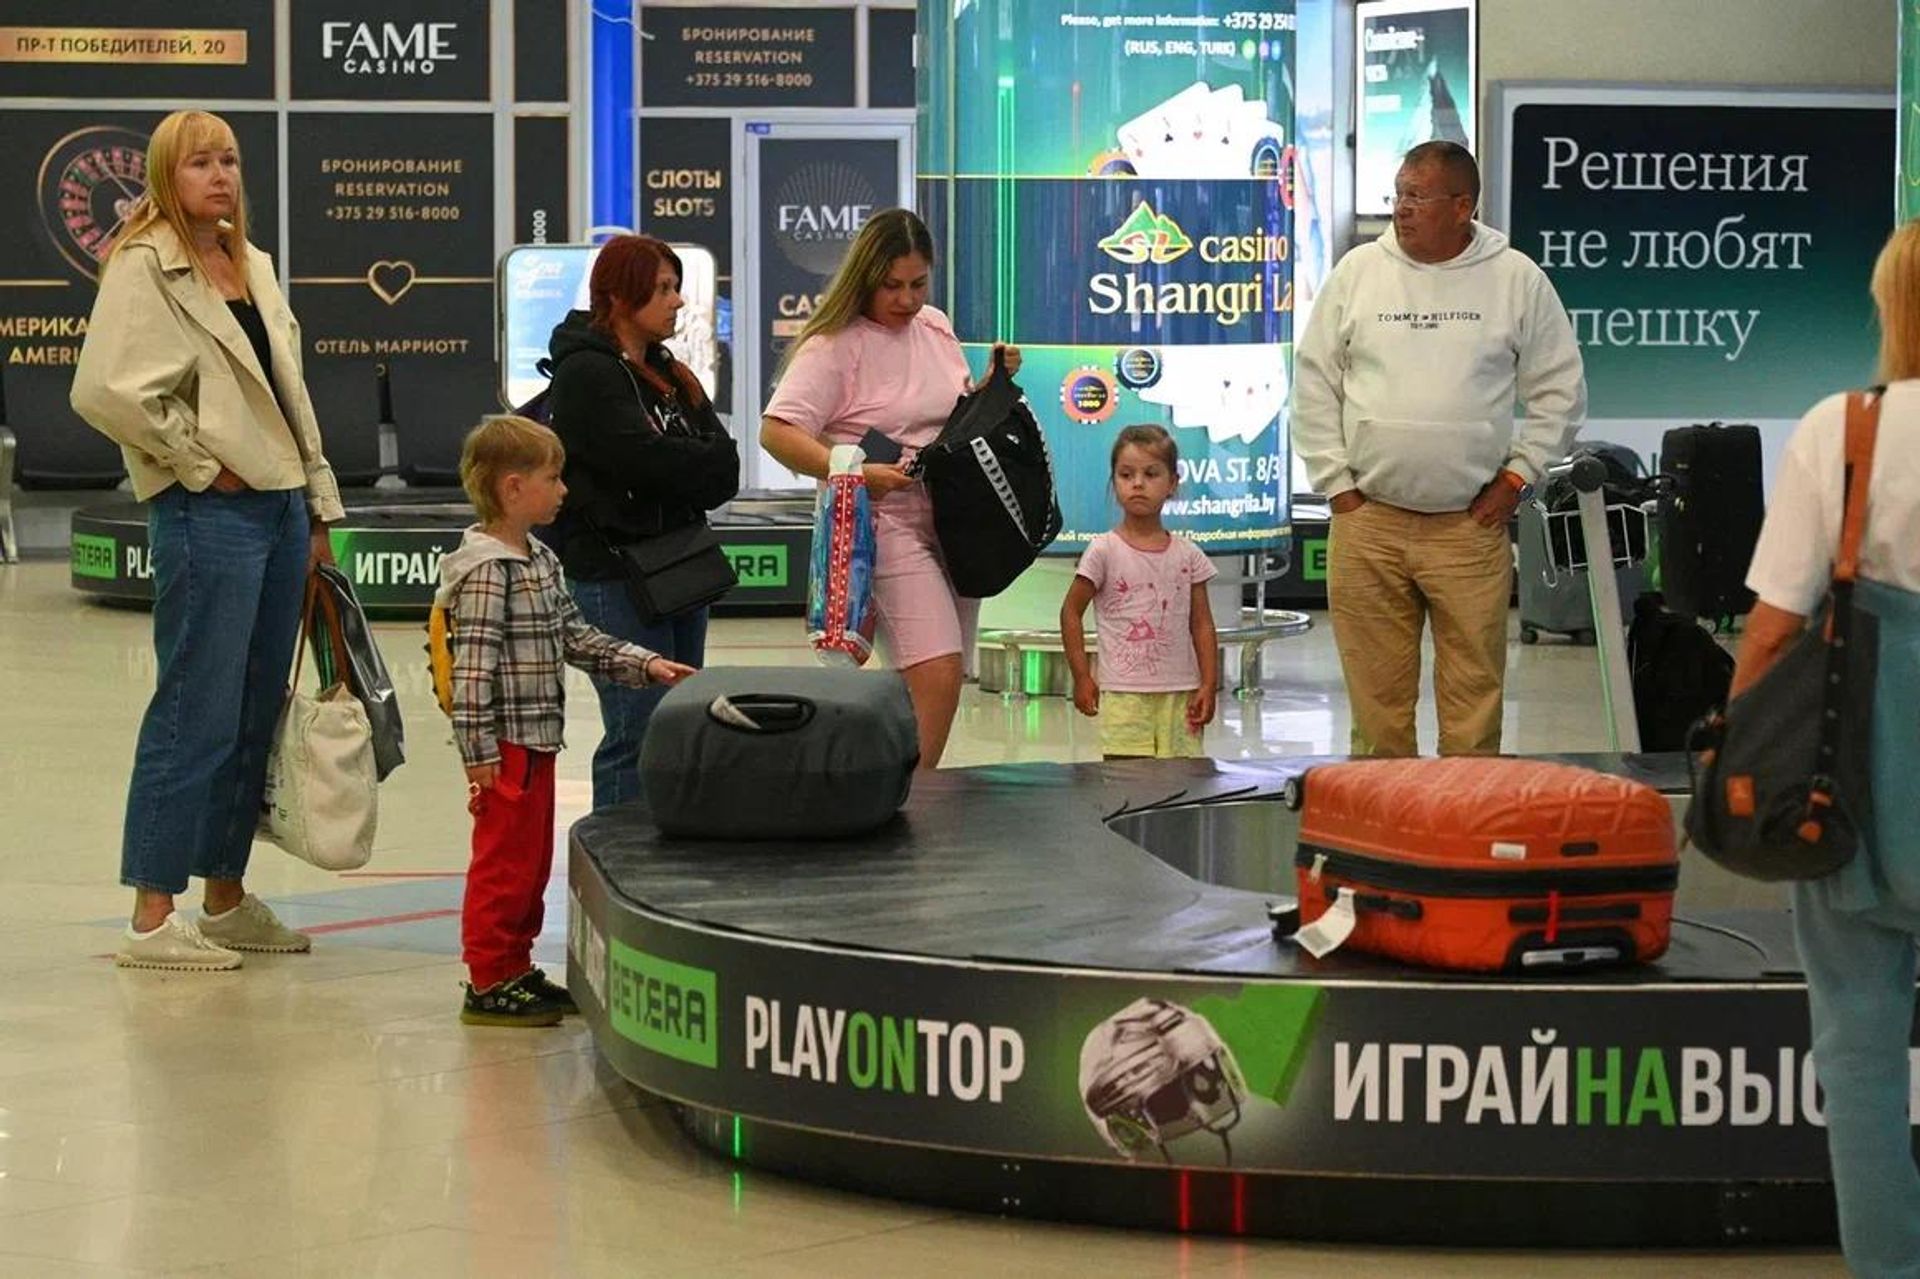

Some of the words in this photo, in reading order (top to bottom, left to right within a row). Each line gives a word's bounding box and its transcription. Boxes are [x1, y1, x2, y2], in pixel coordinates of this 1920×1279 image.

[1061, 14, 1101, 28] Please,
[1124, 15, 1154, 27] more
[1222, 11, 1258, 30] +375
[323, 22, 457, 60] FAME
[681, 27, 816, 43] БРОНИРОВАНИЕ
[17, 37, 55, 52] ПР-Т
[60, 36, 197, 56] ПОБЕДИТЕЛЕЙ,
[203, 40, 225, 55] 20
[1124, 40, 1162, 56] (RUS,
[1165, 41, 1198, 57] ENG,
[343, 60, 435, 75] CASINO
[694, 50, 803, 65] RESERVATION
[686, 74, 721, 88] +375
[724, 74, 742, 88] 29
[746, 74, 813, 88] 516-8000
[321, 159, 463, 174] БРОНИРОВАНИЕ
[1541, 136, 1809, 192] Решения
[334, 182, 450, 197] RESERVATION
[647, 169, 721, 190] СЛОТЫ
[326, 206, 362, 220] +375
[365, 206, 385, 220] 29
[388, 206, 461, 220] 516-8000
[653, 197, 716, 217] SLOTS
[779, 204, 874, 232] FAME
[1199, 226, 1289, 264] casino
[1539, 230, 1608, 268] не
[1622, 213, 1812, 271] любят
[1088, 272, 1263, 326] Shangri
[1378, 313, 1420, 322] TOMMY
[1568, 306, 1761, 361] пешку
[314, 339, 371, 355] ОТЕЛЬ
[375, 339, 470, 355] МАРРИОТТ
[1176, 458, 1222, 483] OVA
[1226, 458, 1253, 483] ST.
[1256, 453, 1280, 485] 8/3
[126, 546, 156, 578] PLA
[745, 995, 1026, 1103] PLAYONTOP
